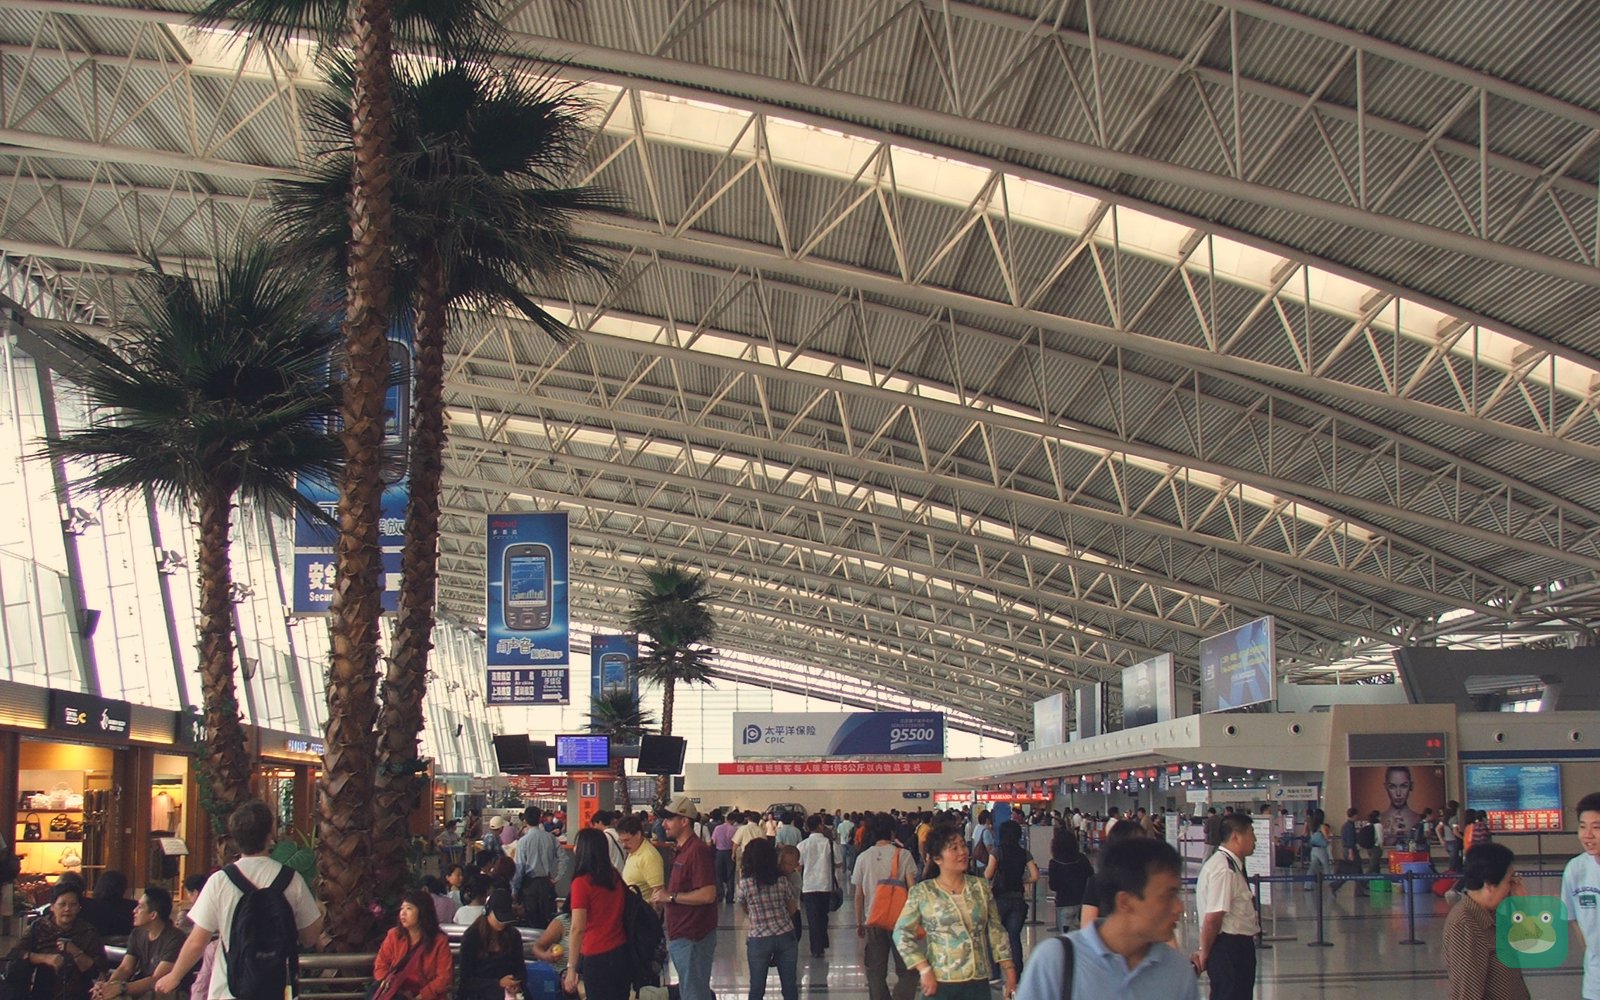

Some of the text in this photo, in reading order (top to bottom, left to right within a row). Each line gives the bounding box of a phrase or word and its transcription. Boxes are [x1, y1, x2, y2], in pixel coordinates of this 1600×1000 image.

[308, 562, 336, 590] 安全
[309, 592, 333, 602] Secur
[764, 725, 816, 736] 太平洋保险
[890, 728, 934, 743] 95500
[764, 736, 785, 744] CPIC
